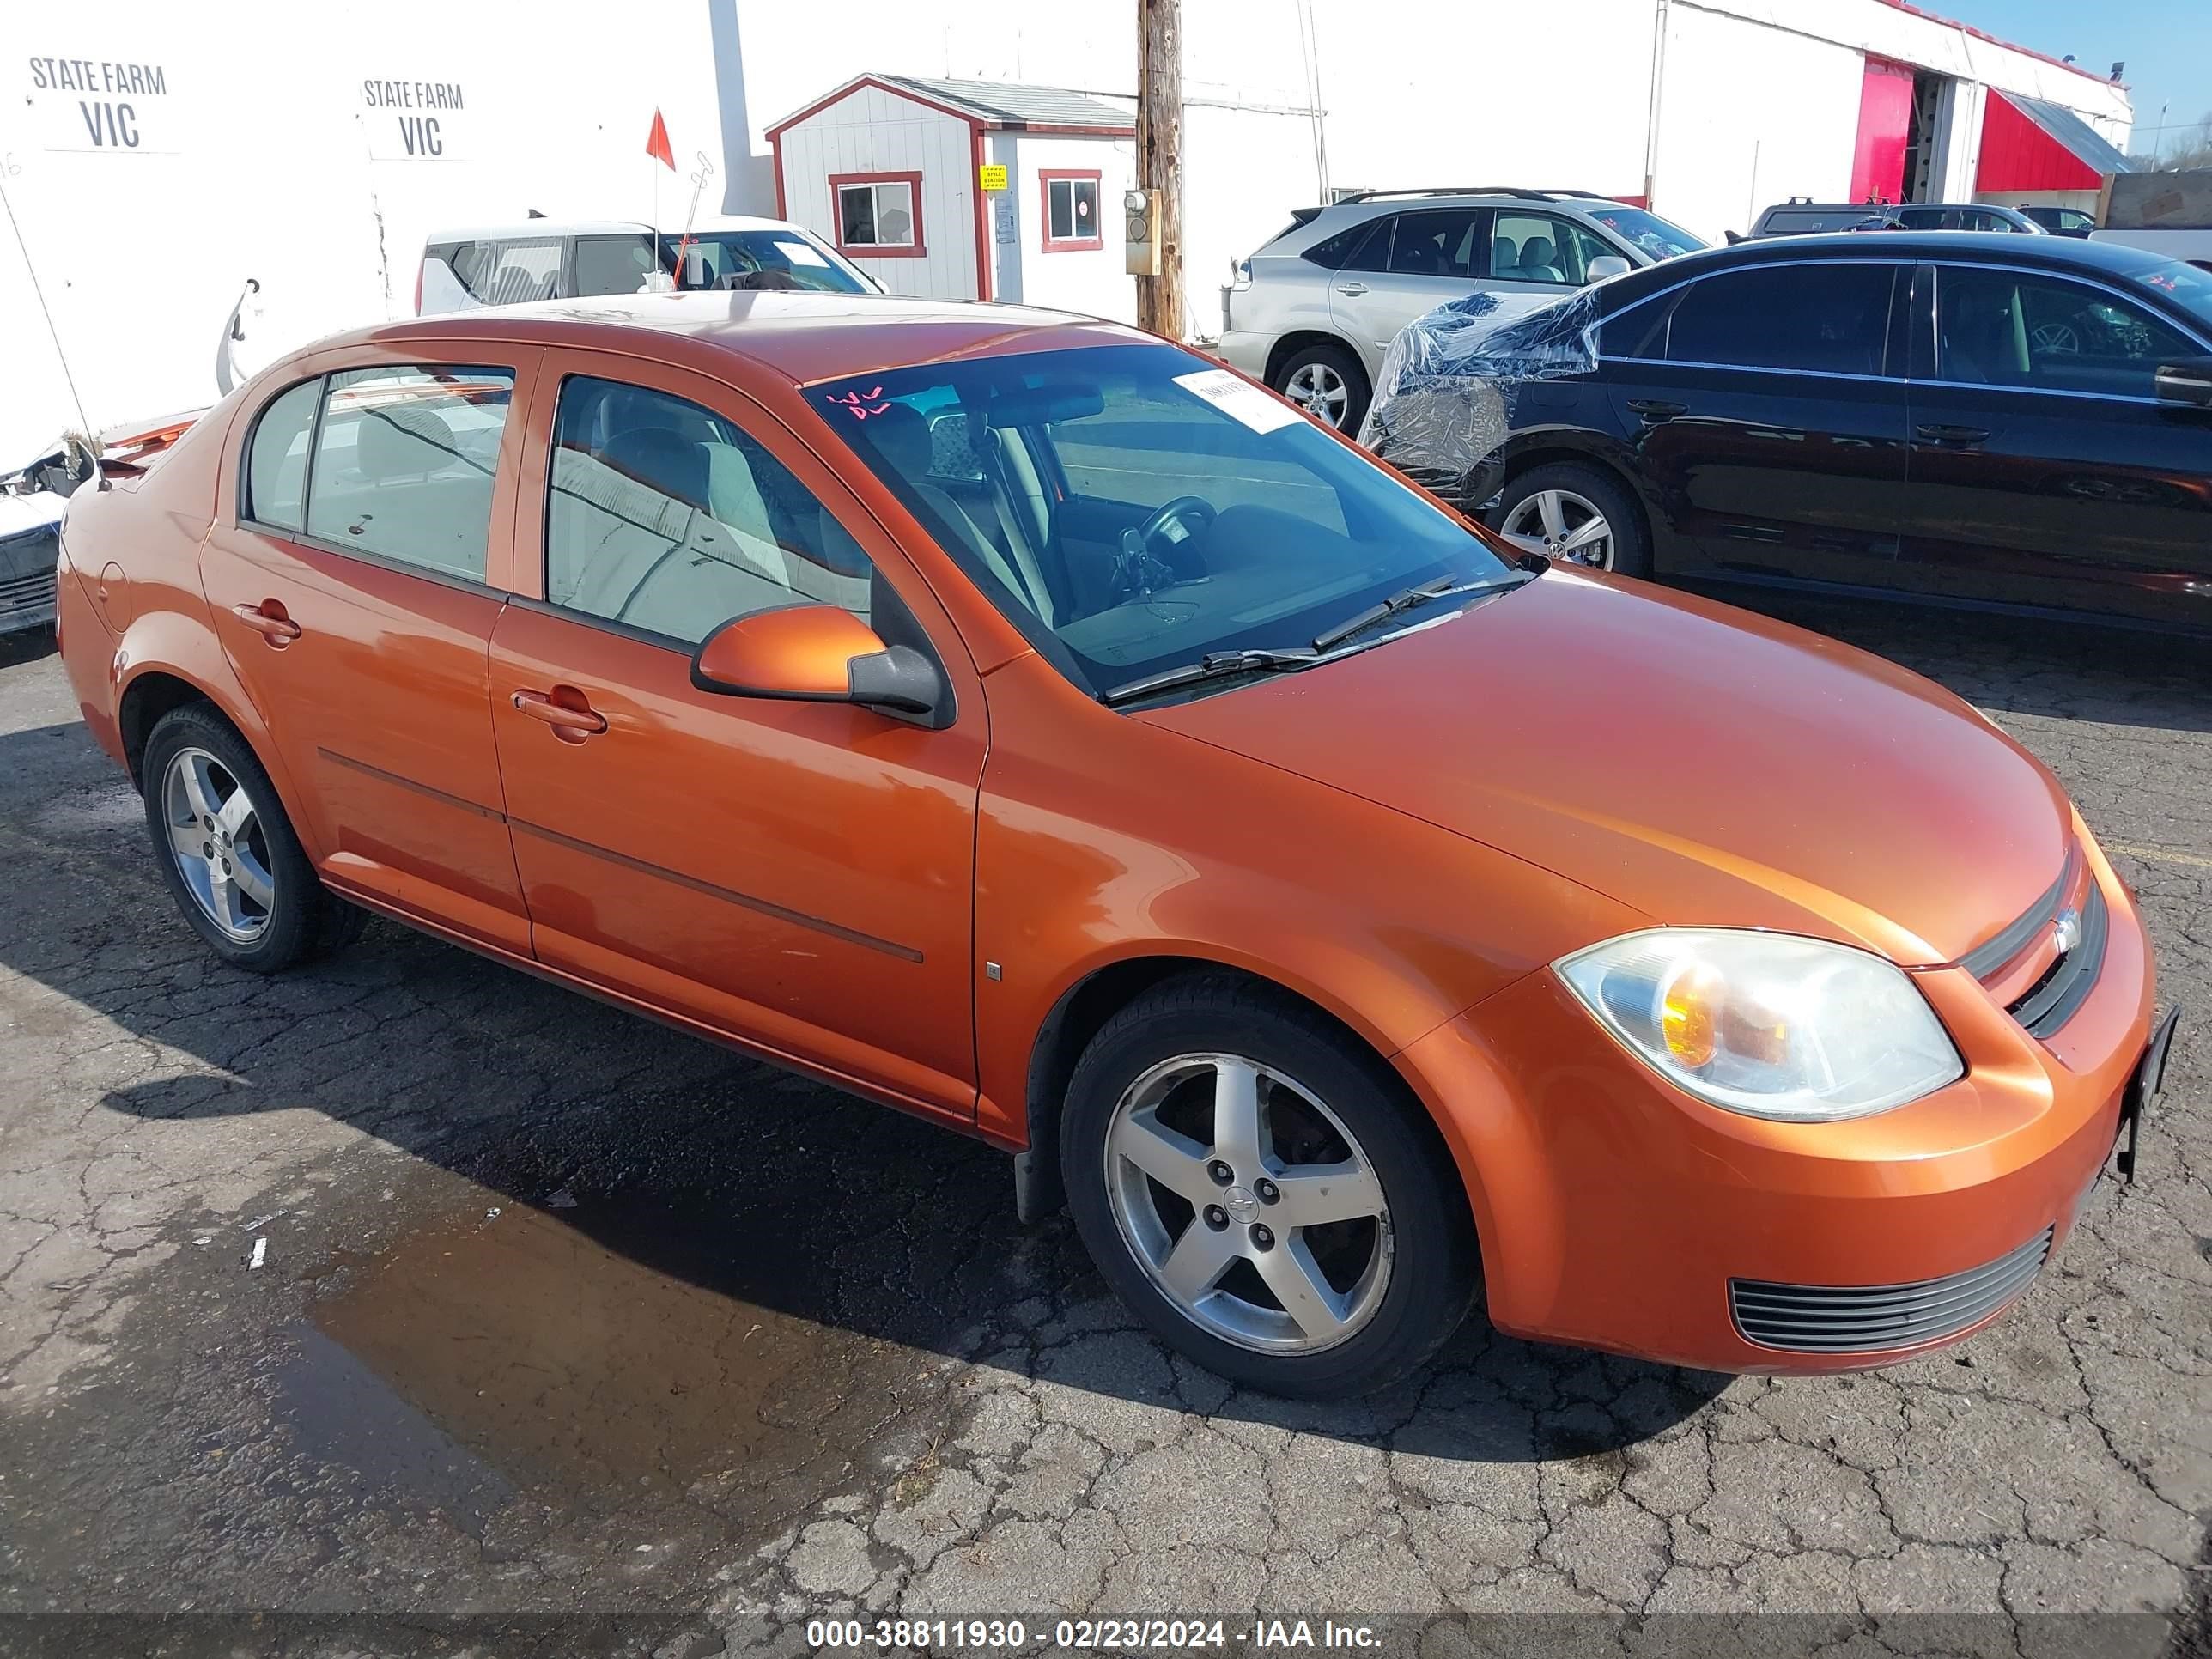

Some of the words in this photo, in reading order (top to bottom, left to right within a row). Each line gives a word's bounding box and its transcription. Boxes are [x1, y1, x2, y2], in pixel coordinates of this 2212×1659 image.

[28, 57, 100, 92] STATE
[101, 62, 167, 95] FARM
[364, 80, 413, 108] STATE
[415, 82, 464, 110] FARM
[79, 100, 140, 148] VIC
[398, 116, 443, 156] VIC
